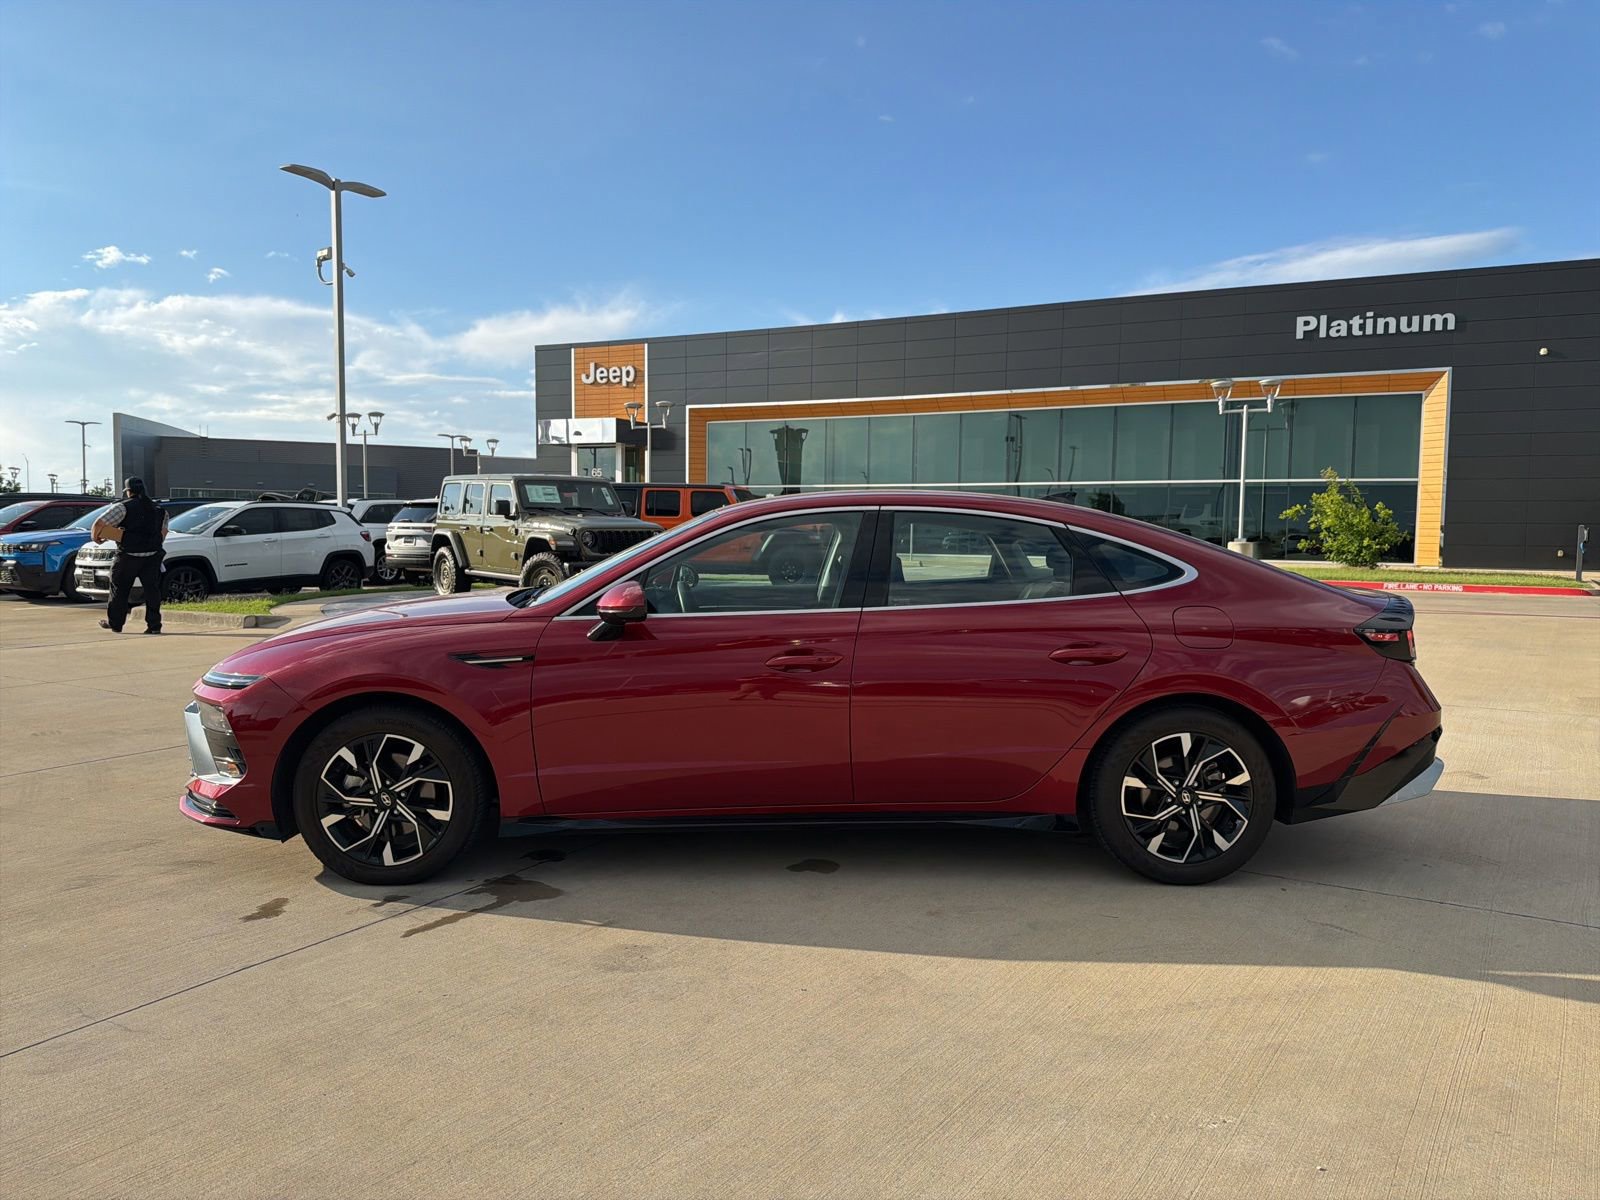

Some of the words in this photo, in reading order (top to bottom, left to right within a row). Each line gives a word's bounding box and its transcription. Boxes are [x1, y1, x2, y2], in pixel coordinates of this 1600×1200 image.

[1296, 311, 1456, 340] Platinum
[581, 361, 635, 387] Jeep
[1434, 584, 1464, 592] PARKING
